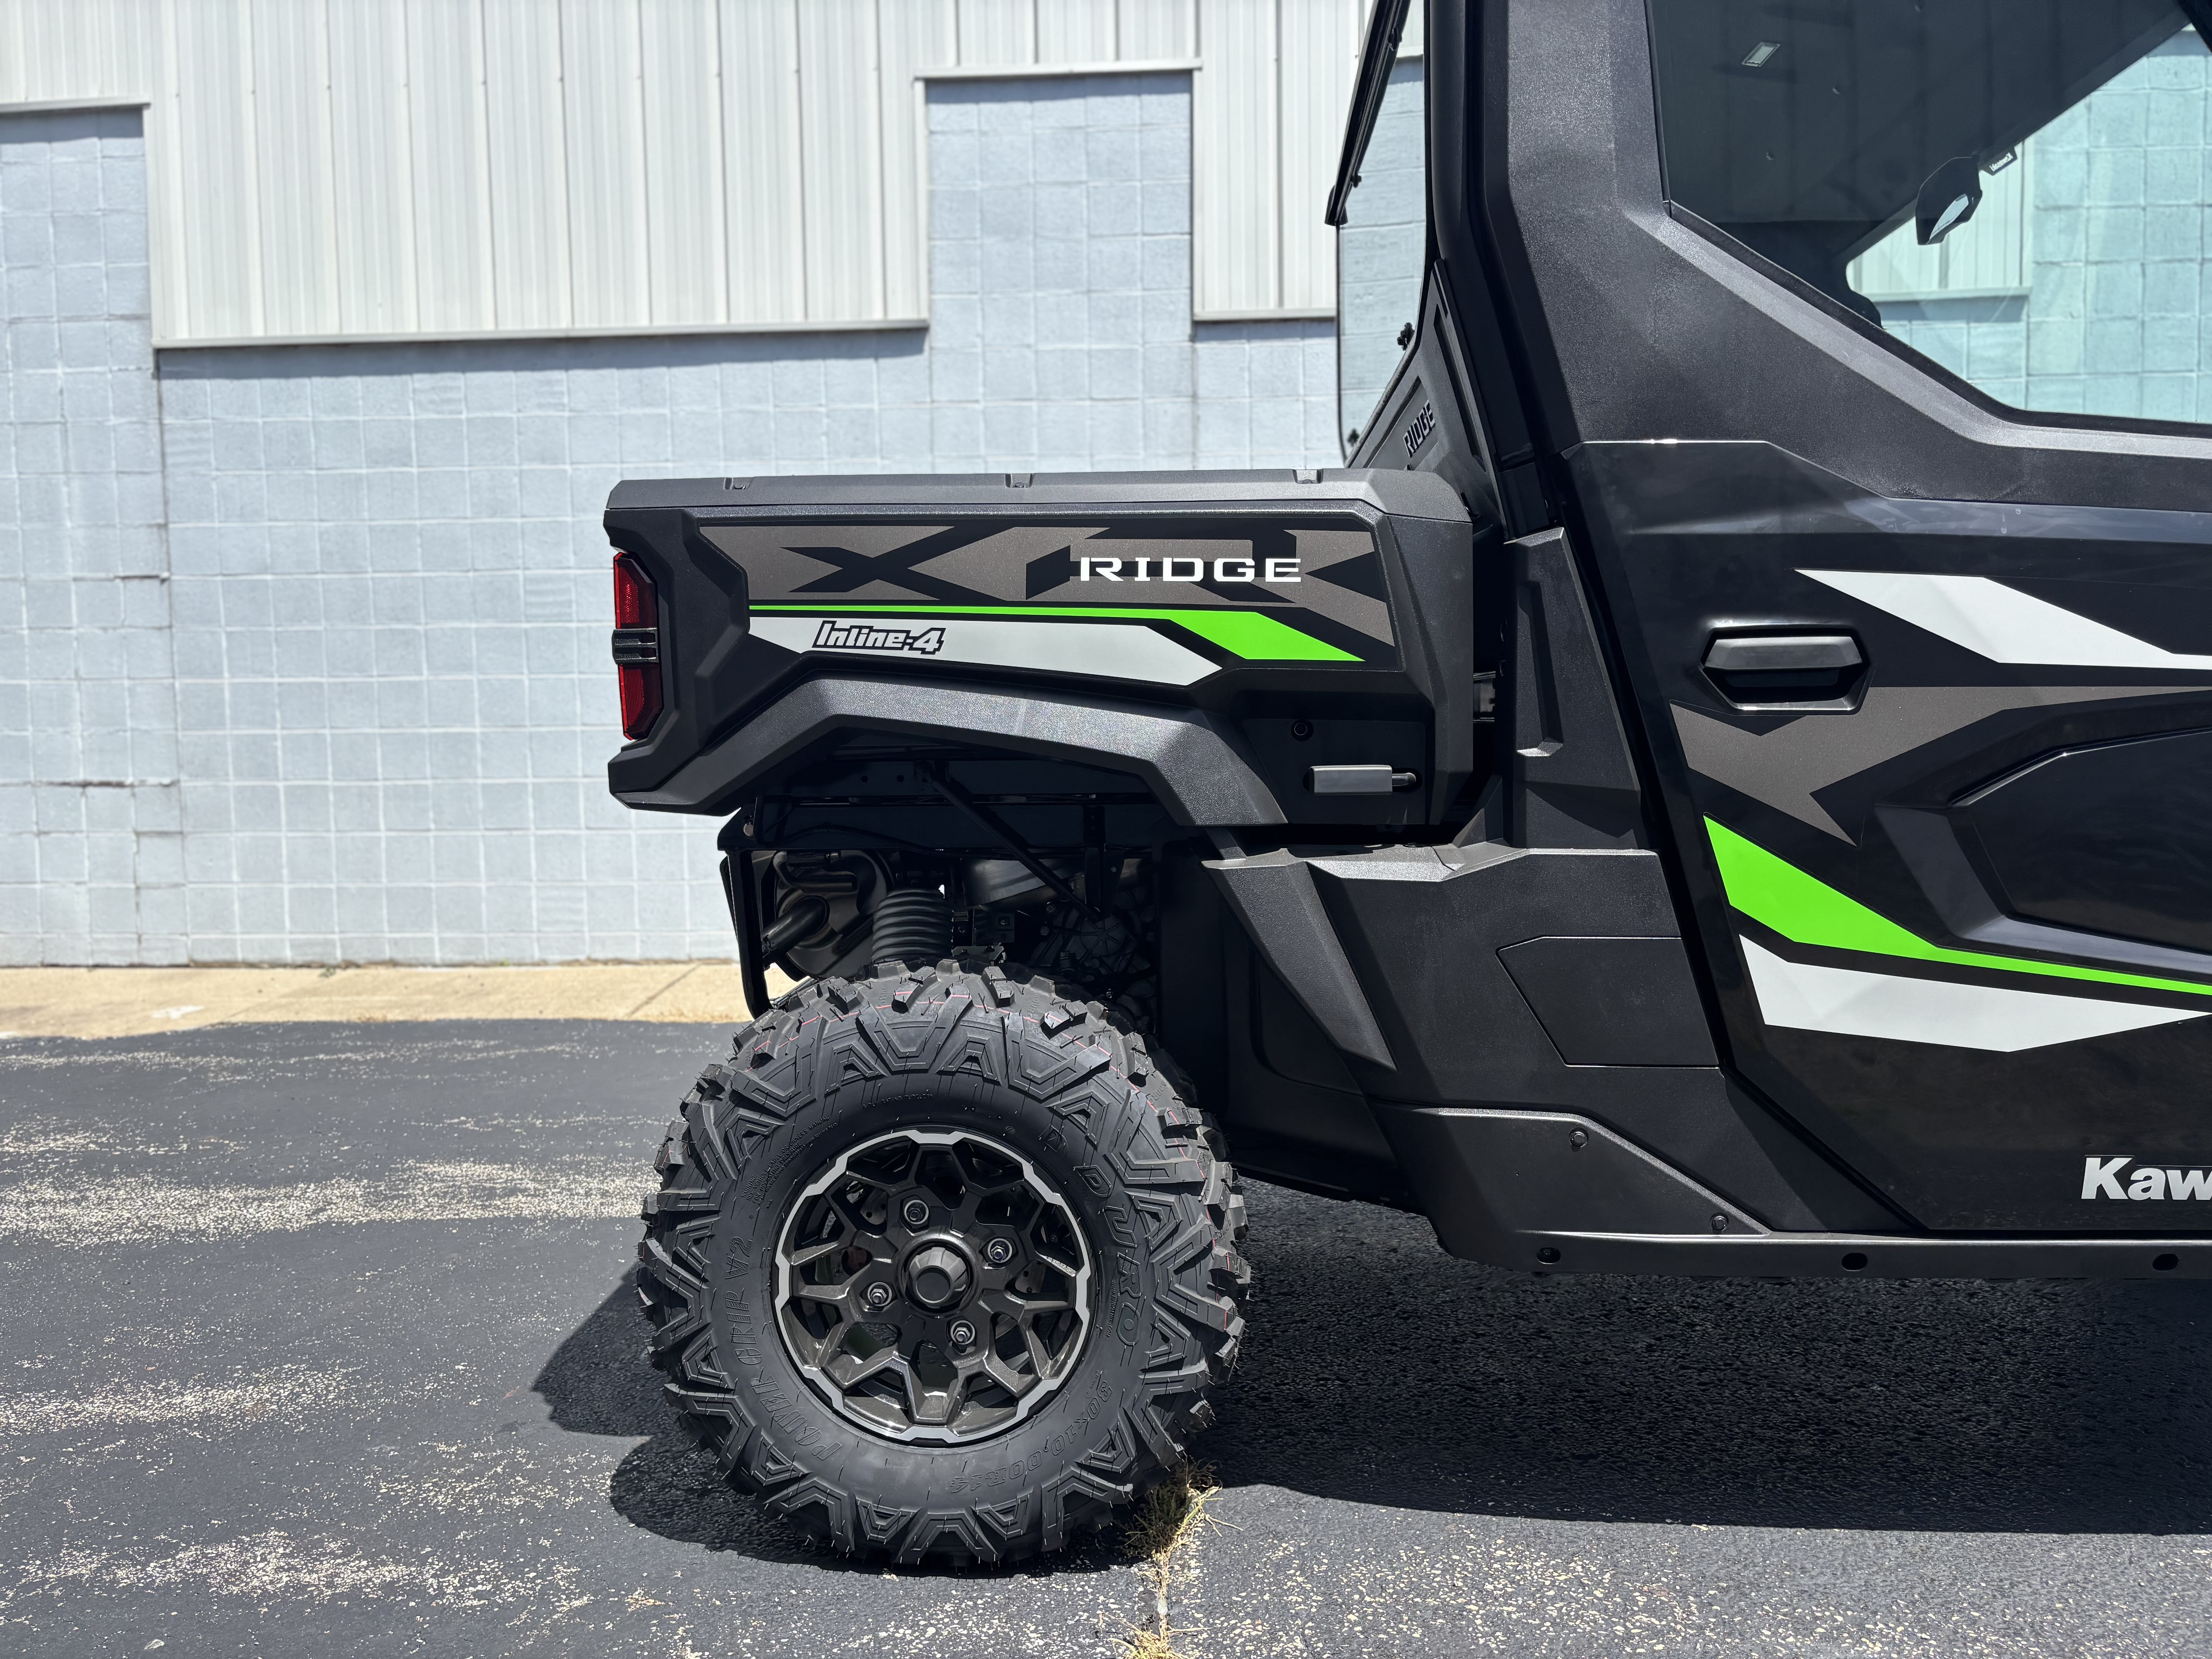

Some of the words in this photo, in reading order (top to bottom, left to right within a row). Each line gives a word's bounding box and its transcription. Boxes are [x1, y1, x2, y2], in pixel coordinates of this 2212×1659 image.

[1403, 400, 1435, 457] RIDGE
[1080, 557, 1301, 582] RIDGE
[812, 620, 946, 654] Inline-4
[2081, 1158, 2212, 1200] Kaw
[725, 1236, 753, 1279] V2
[1073, 1163, 1142, 1346] DURO
[725, 1291, 763, 1365] GRIP
[750, 1374, 843, 1461] POWER
